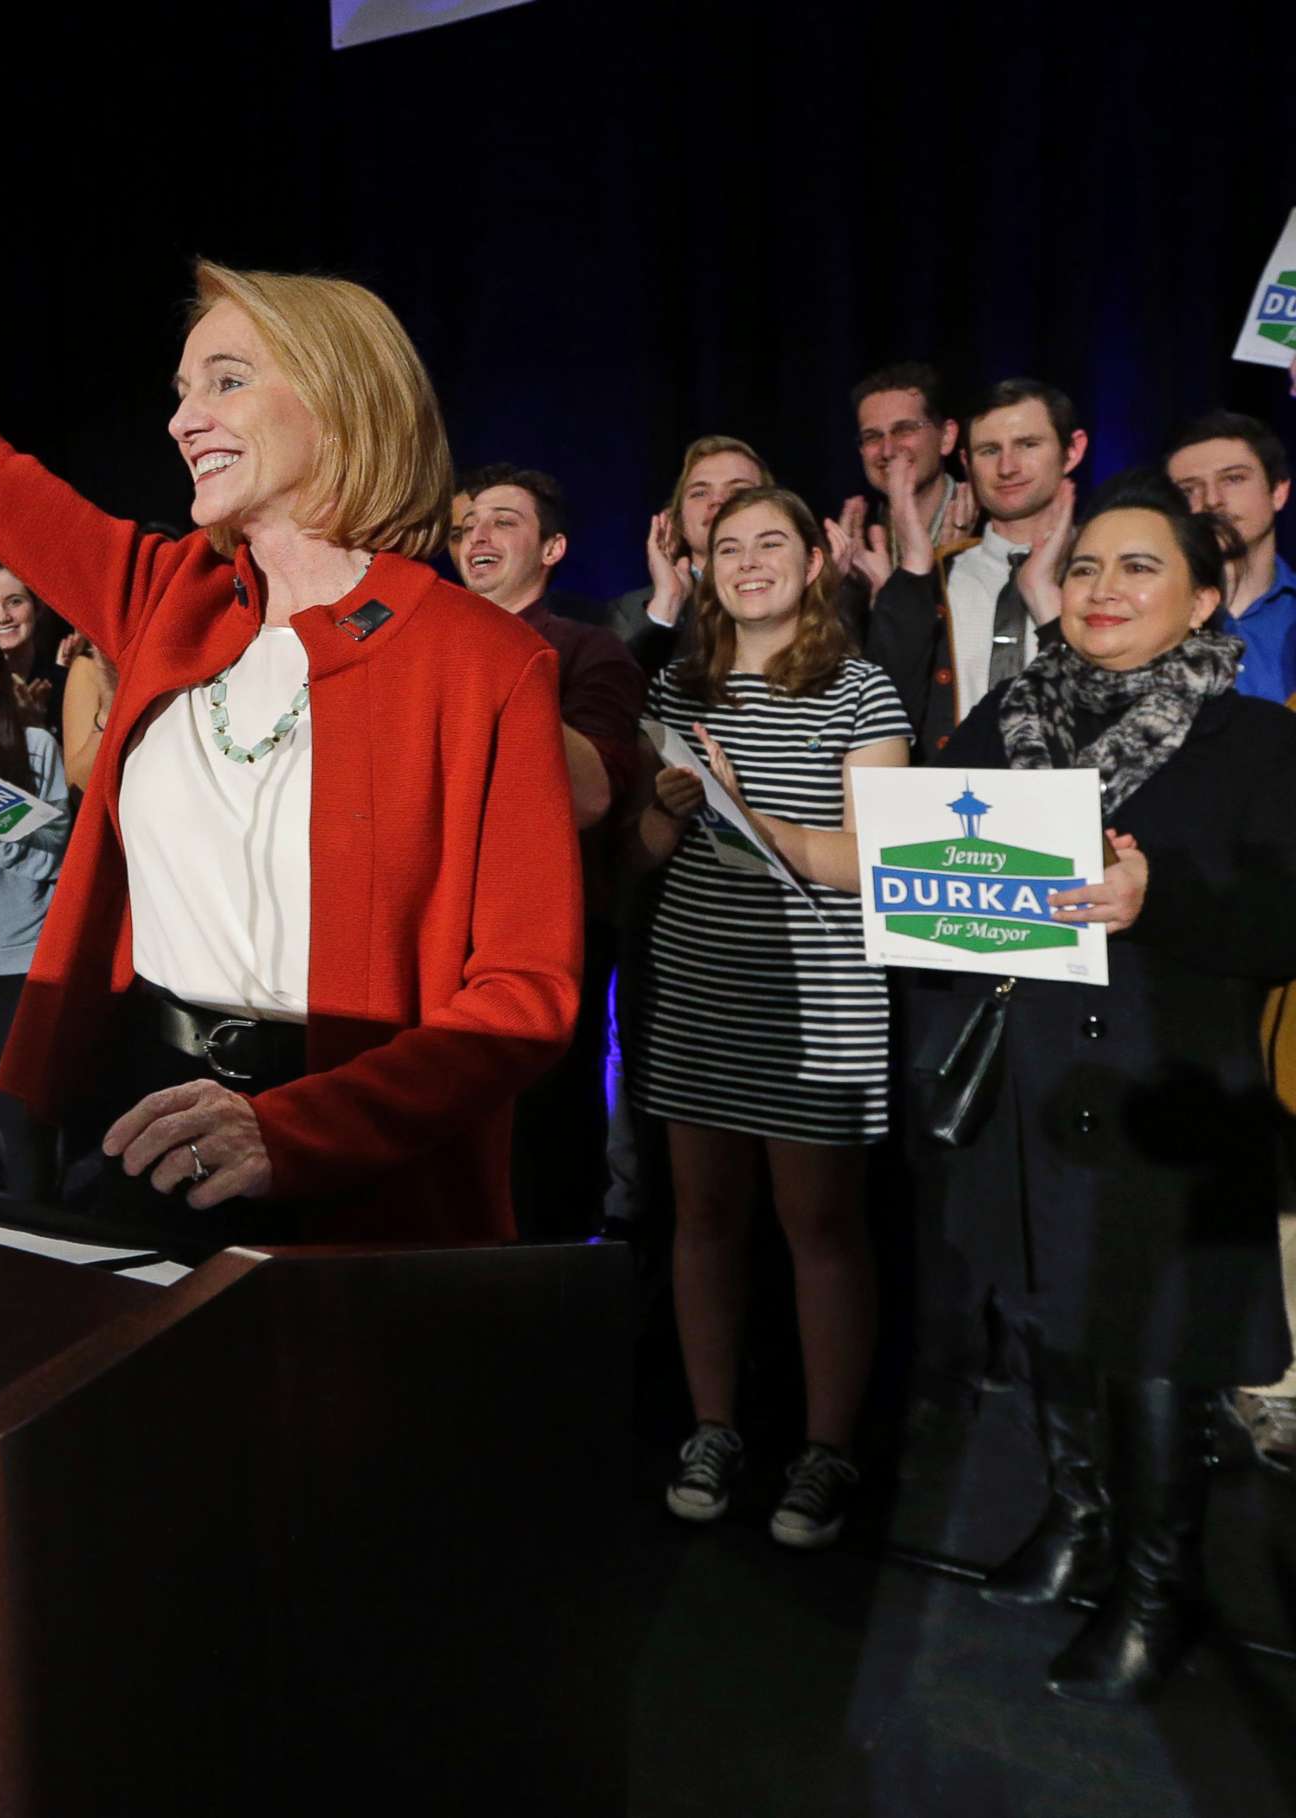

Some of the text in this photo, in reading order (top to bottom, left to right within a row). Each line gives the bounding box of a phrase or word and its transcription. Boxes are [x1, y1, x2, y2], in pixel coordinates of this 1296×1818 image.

[941, 845, 1007, 872] Jenny
[930, 917, 1032, 945] for Mayor
